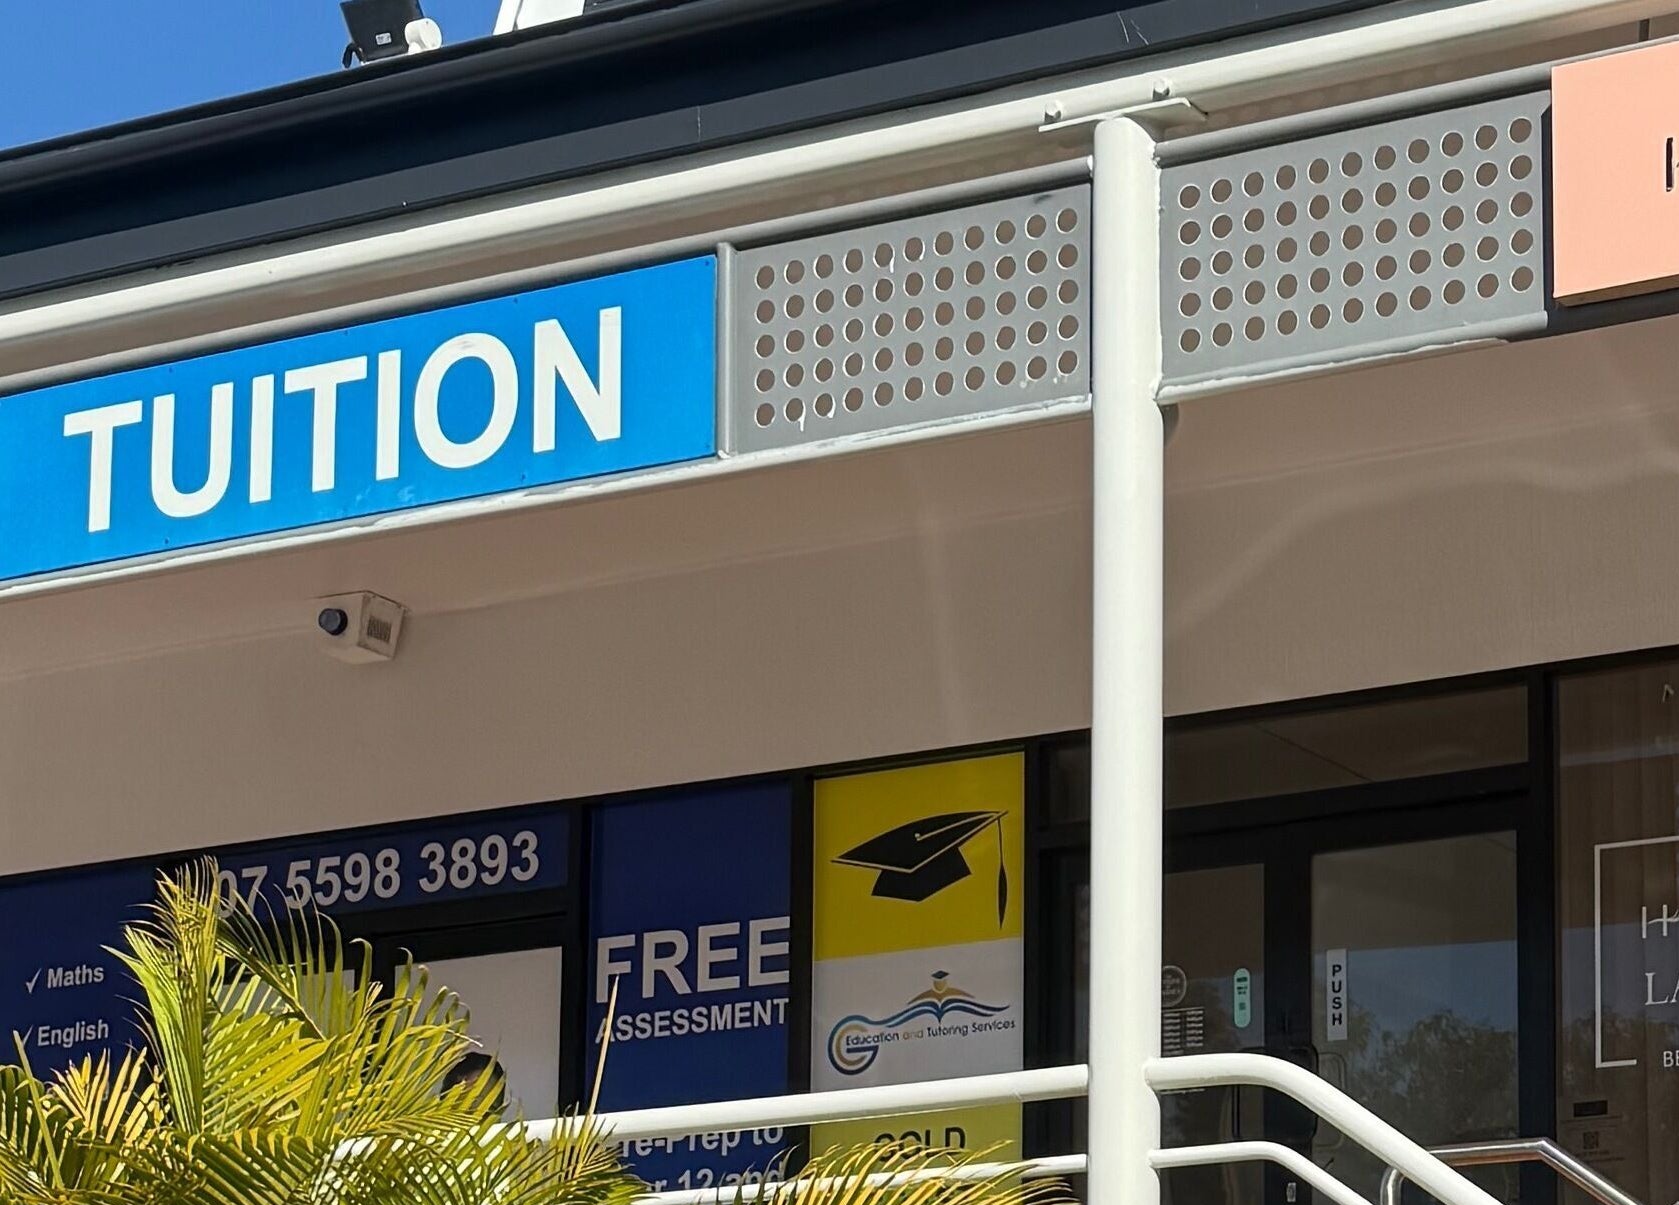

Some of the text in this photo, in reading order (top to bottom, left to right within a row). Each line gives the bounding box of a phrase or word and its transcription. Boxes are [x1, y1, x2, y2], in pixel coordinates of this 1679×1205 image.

[62, 305, 623, 533] TUITION
[285, 848, 401, 910] 5598
[418, 831, 540, 893] 3893
[47, 964, 104, 988] Maths
[595, 916, 791, 1003] FREE
[1332, 964, 1343, 1027] PUSH
[37, 1019, 109, 1048] English
[846, 1018, 1016, 1046] Education and Tutoring Services
